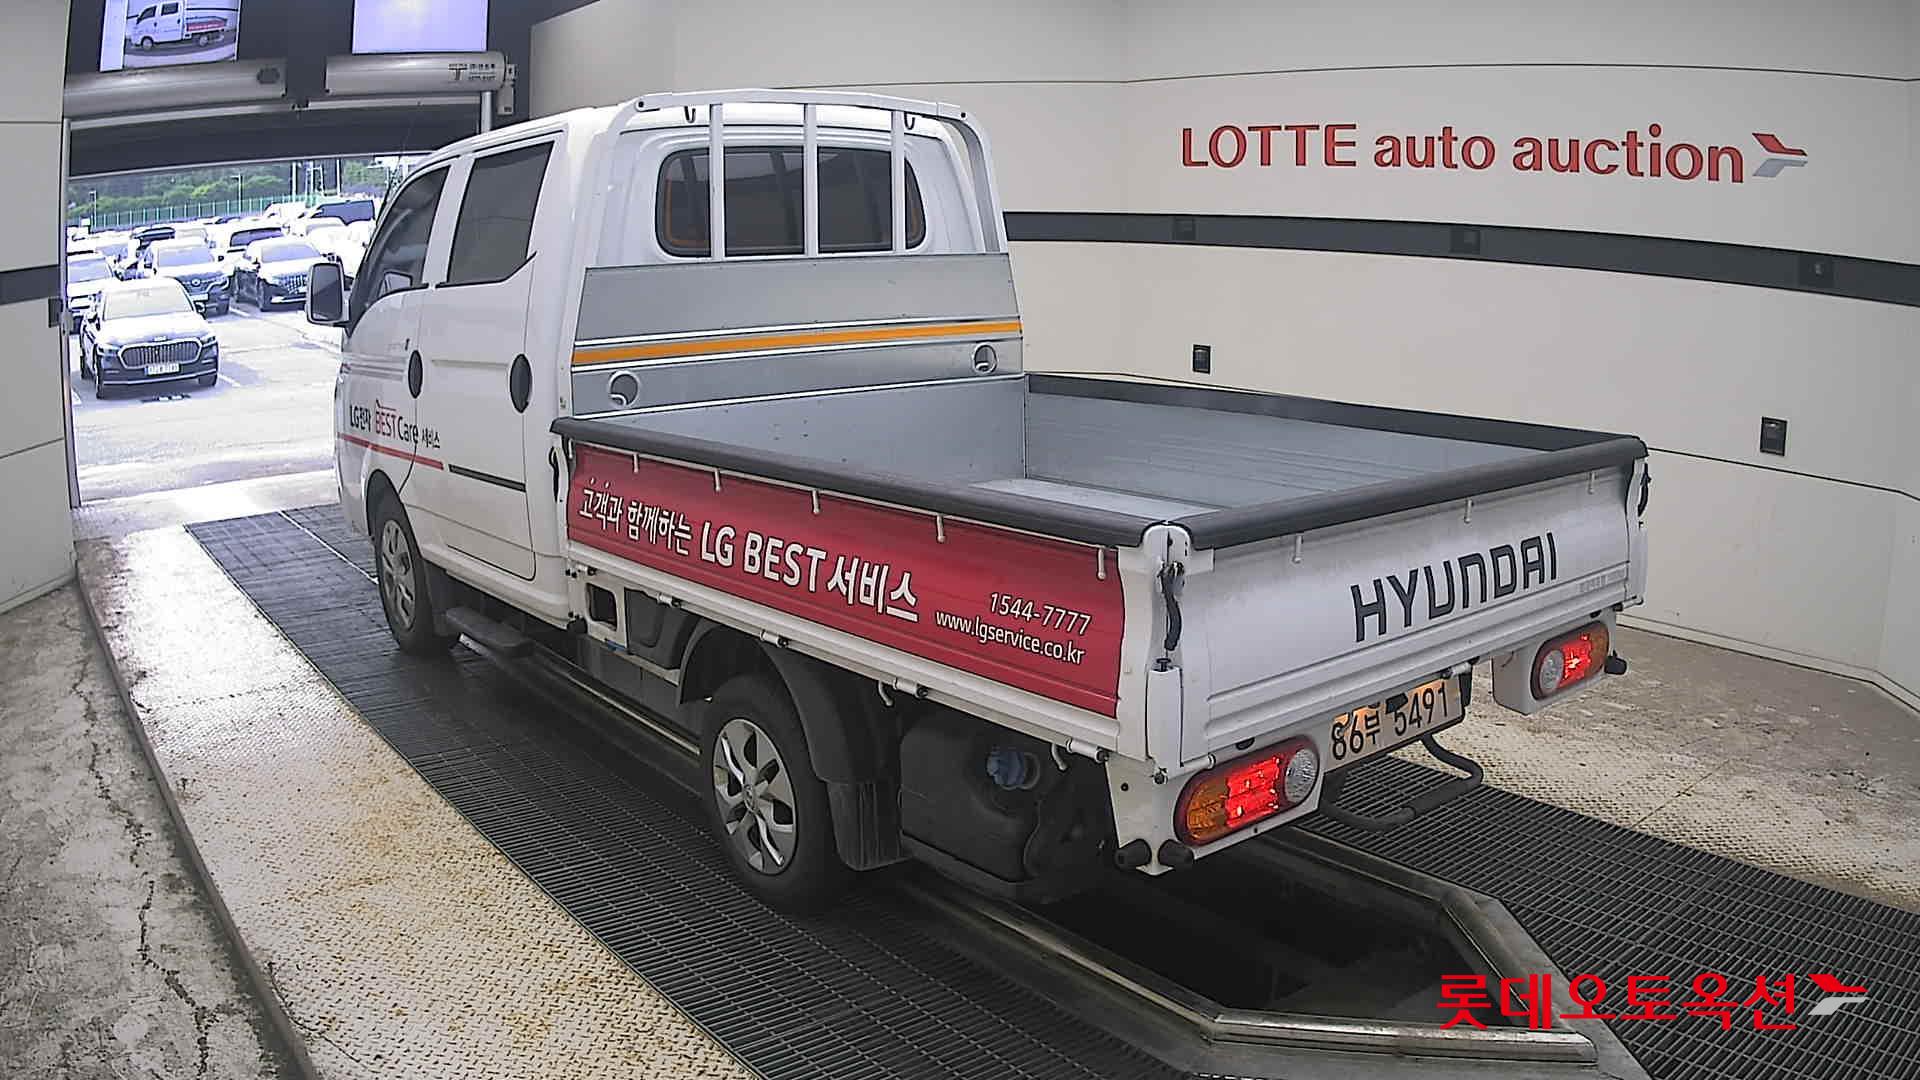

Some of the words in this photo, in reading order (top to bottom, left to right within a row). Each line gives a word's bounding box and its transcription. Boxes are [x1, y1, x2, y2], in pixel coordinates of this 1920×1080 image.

[1182, 123, 1357, 168] LOTTE
[1374, 126, 1496, 170] auto
[1512, 123, 1744, 183] auction
[579, 477, 623, 533] 고객과
[627, 500, 692, 556] 함께하는
[701, 521, 736, 567] LG
[990, 592, 1092, 636] 1544-7777
[1350, 531, 1558, 643] HYUNDAI
[935, 611, 1086, 665] www.lgservice.co.kr
[1394, 681, 1448, 736] 5491
